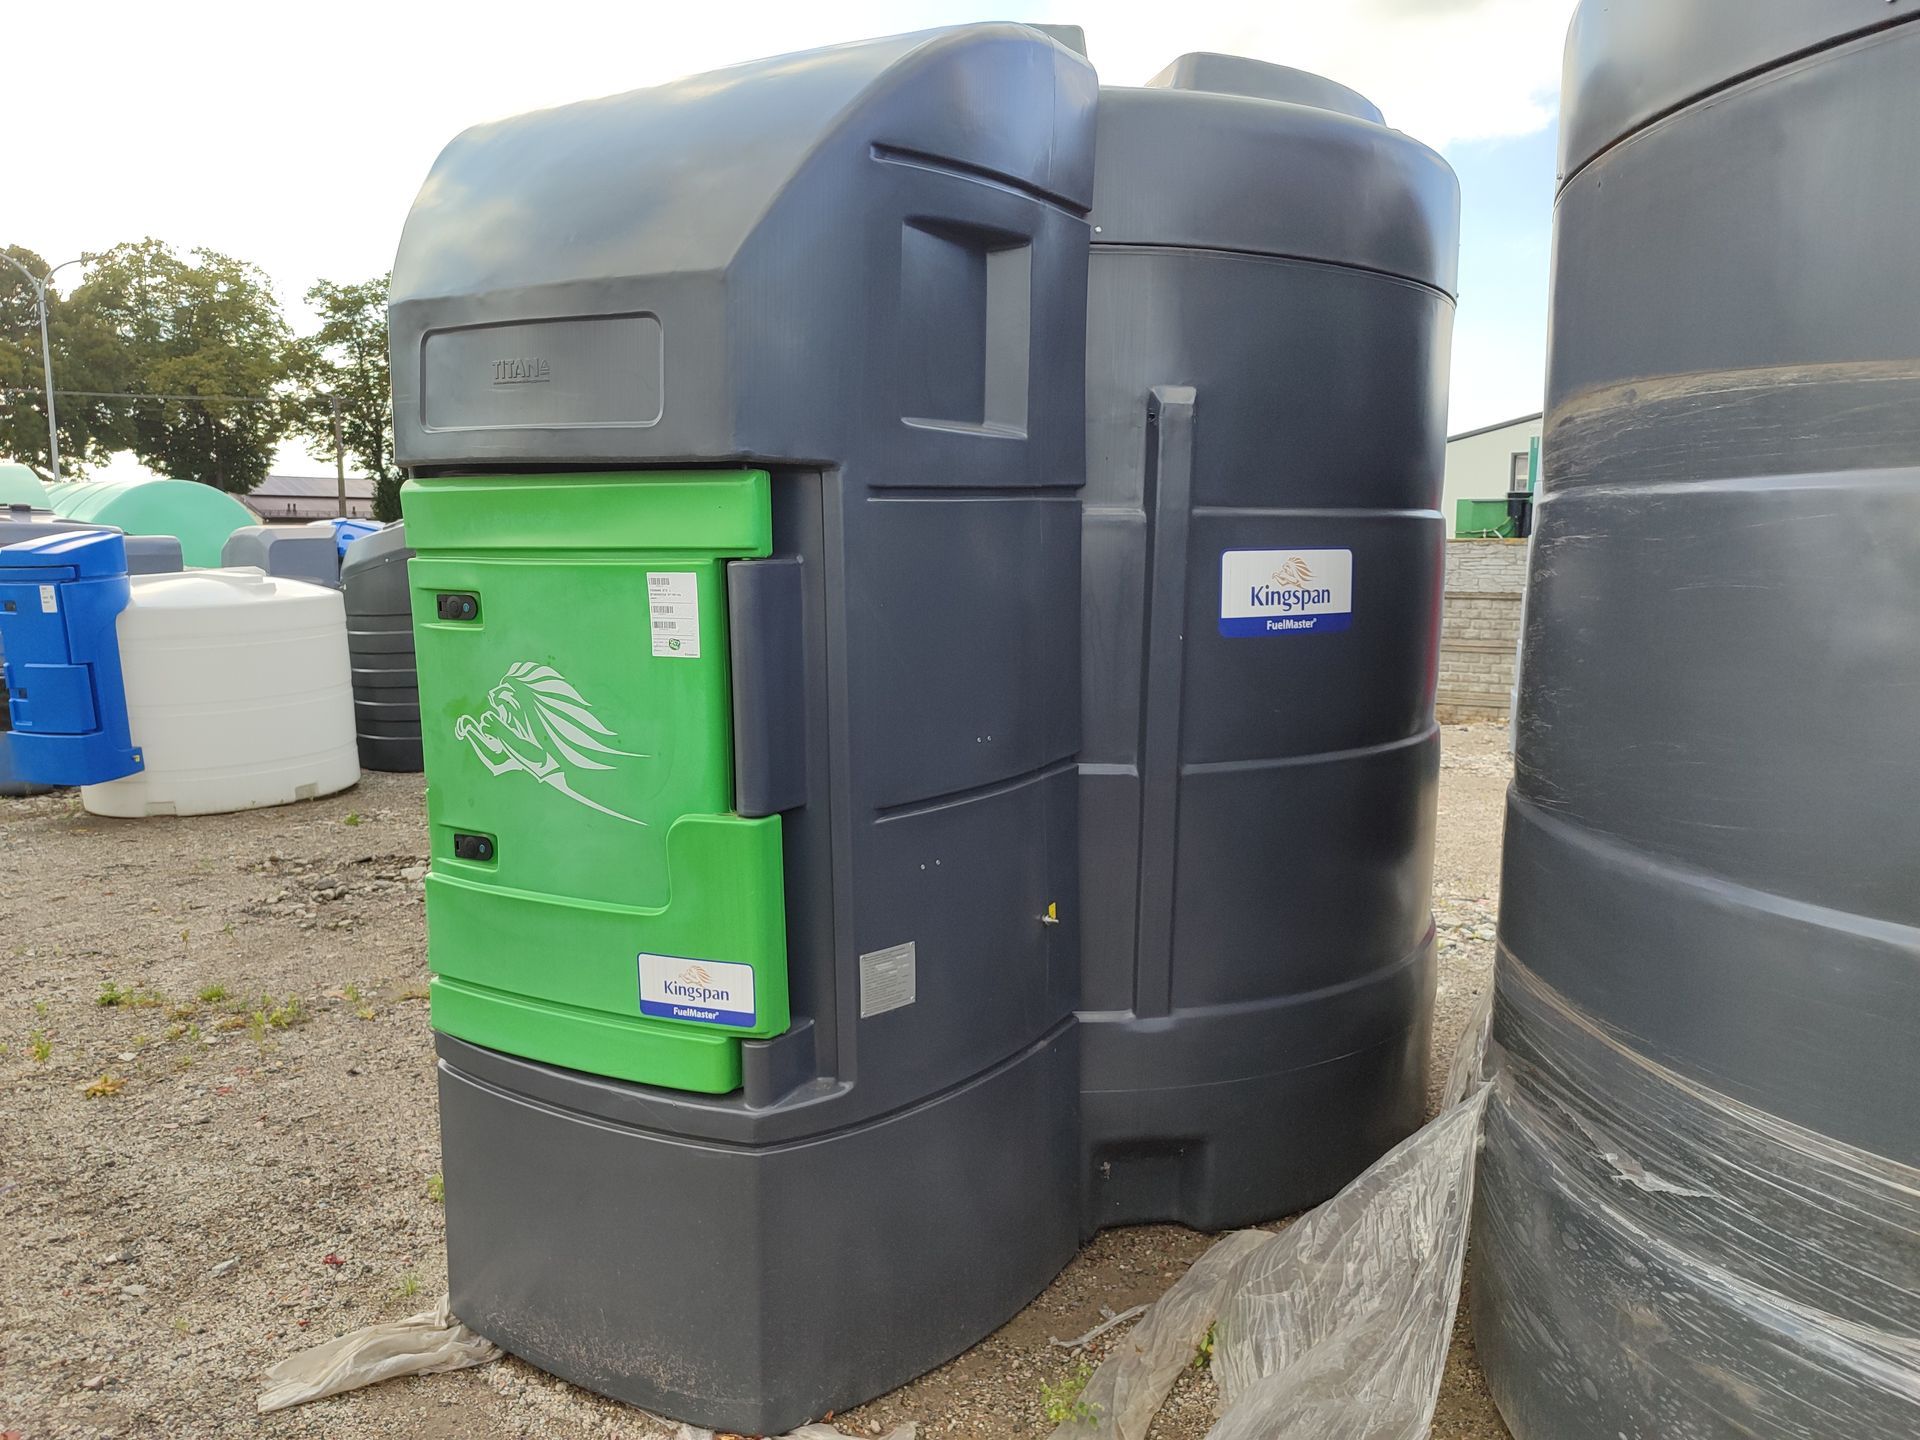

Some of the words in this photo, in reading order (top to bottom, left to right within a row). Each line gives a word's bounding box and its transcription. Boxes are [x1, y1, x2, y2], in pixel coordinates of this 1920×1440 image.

[492, 358, 540, 380] TITAN
[1251, 584, 1331, 612] Kingspan
[664, 980, 730, 1003] Kingspan
